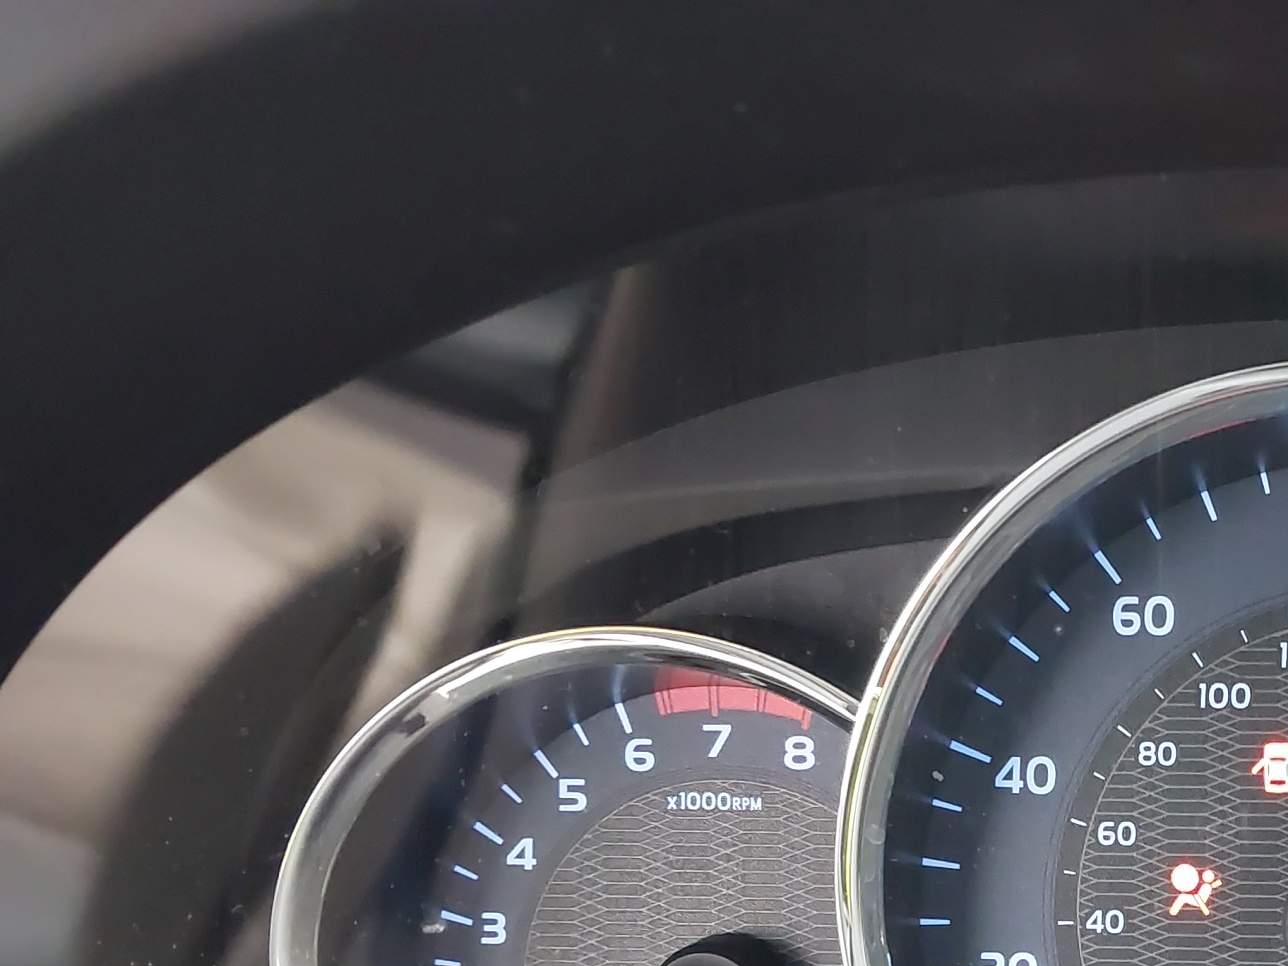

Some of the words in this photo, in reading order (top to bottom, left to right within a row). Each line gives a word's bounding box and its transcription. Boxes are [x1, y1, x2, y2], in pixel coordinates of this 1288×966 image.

[1112, 595, 1176, 637] 60
[1199, 682, 1251, 709] 100
[624, 738, 655, 772] 6
[702, 725, 731, 757] 7
[783, 736, 816, 770] 8
[1137, 741, 1177, 766] 80
[995, 756, 1056, 794] 40
[558, 779, 587, 811] 5
[1097, 821, 1136, 846] 60
[506, 838, 536, 870] 4
[481, 912, 507, 944] 3
[1085, 910, 1125, 934] 40
